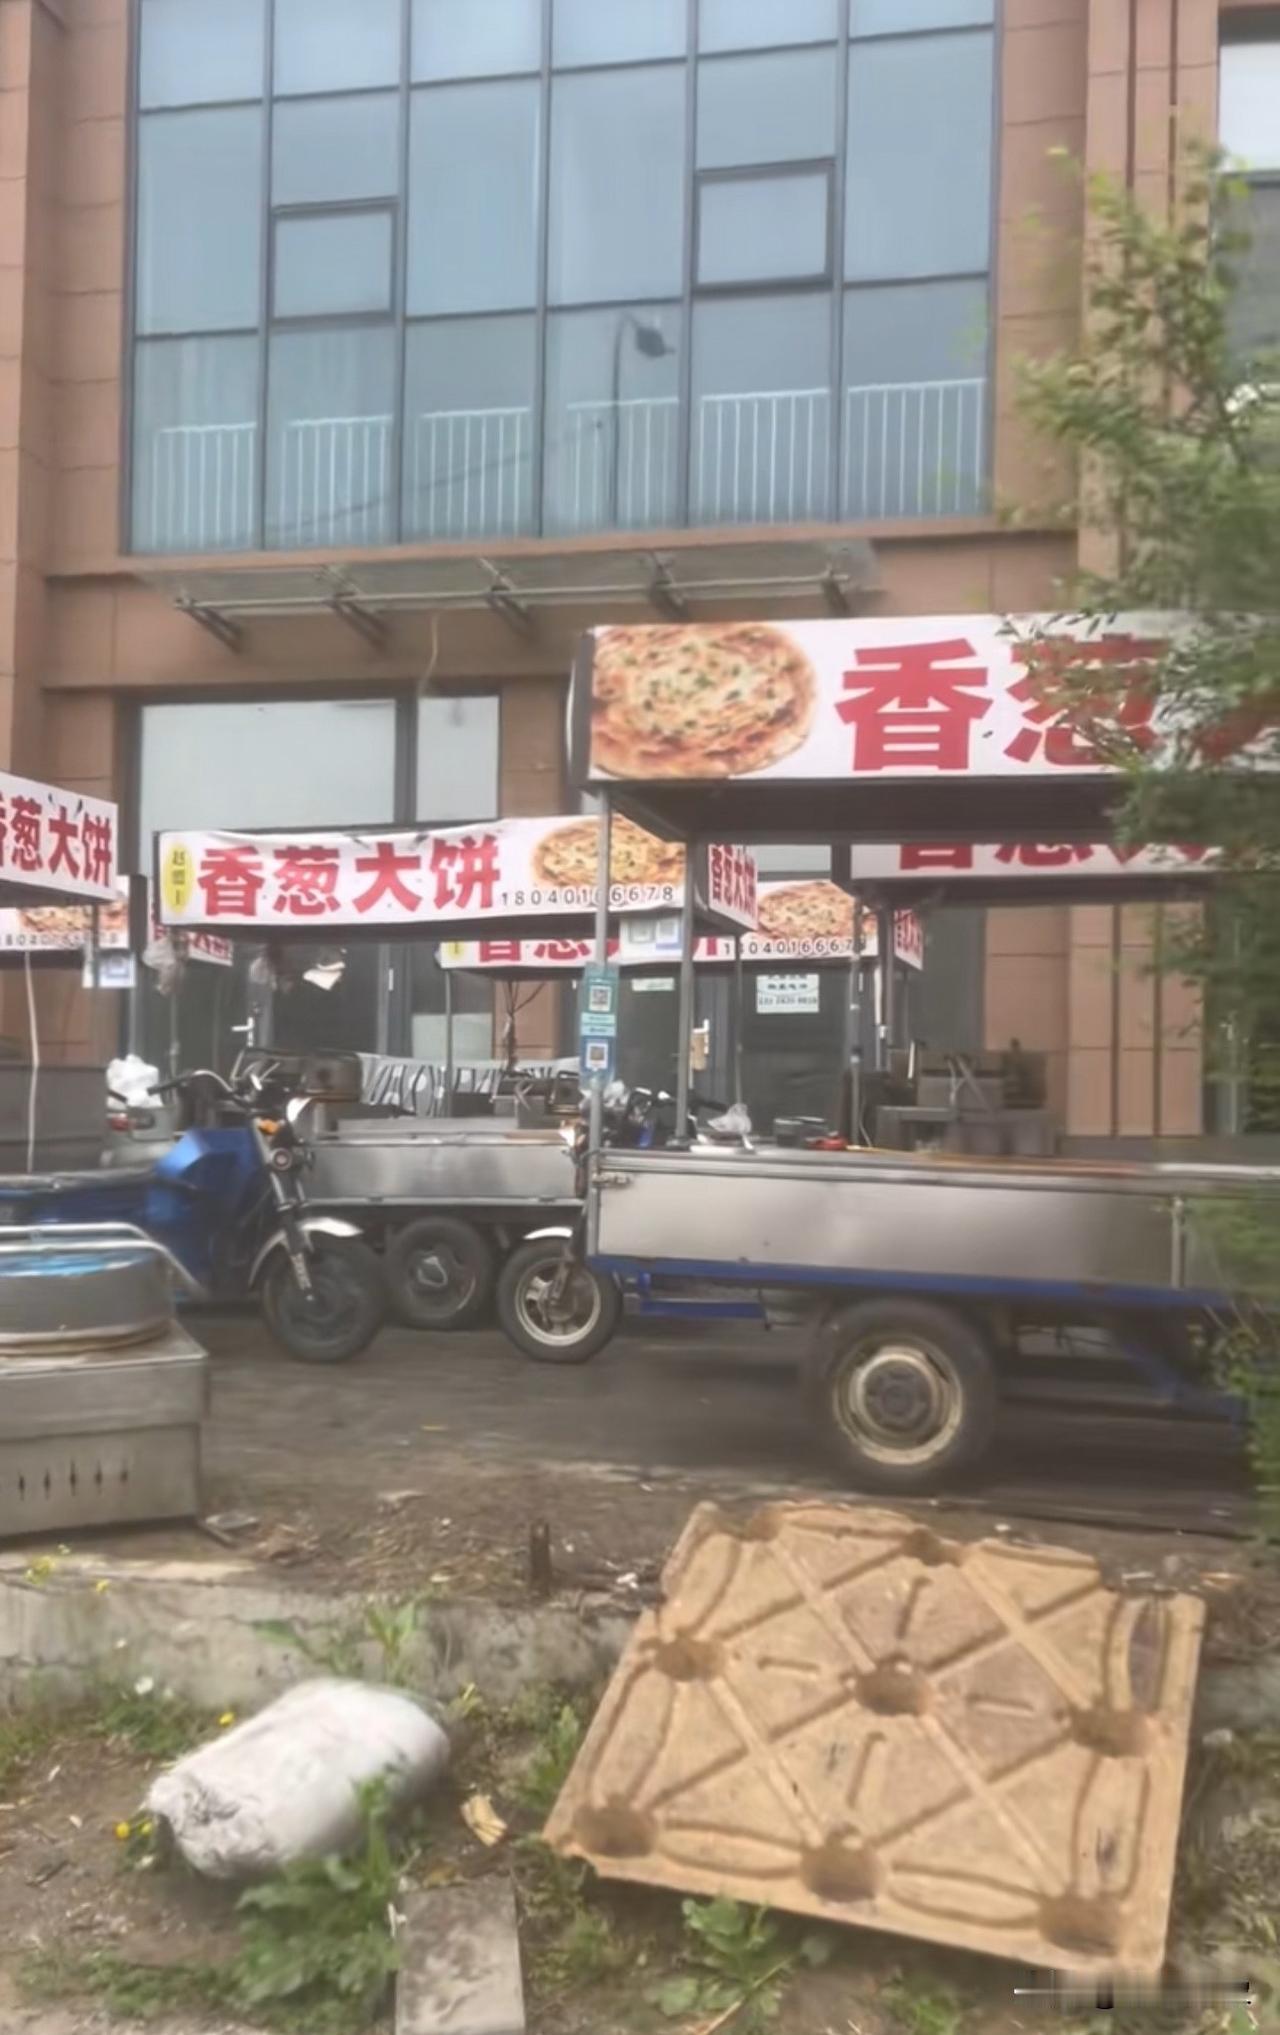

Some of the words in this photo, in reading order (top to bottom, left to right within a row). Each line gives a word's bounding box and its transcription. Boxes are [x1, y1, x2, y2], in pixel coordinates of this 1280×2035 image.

[0, 789, 112, 888] 葱大饼
[197, 834, 501, 917] 香葱大饼
[502, 886, 673, 906] 1804016678
[723, 938, 867, 955] 104016667
